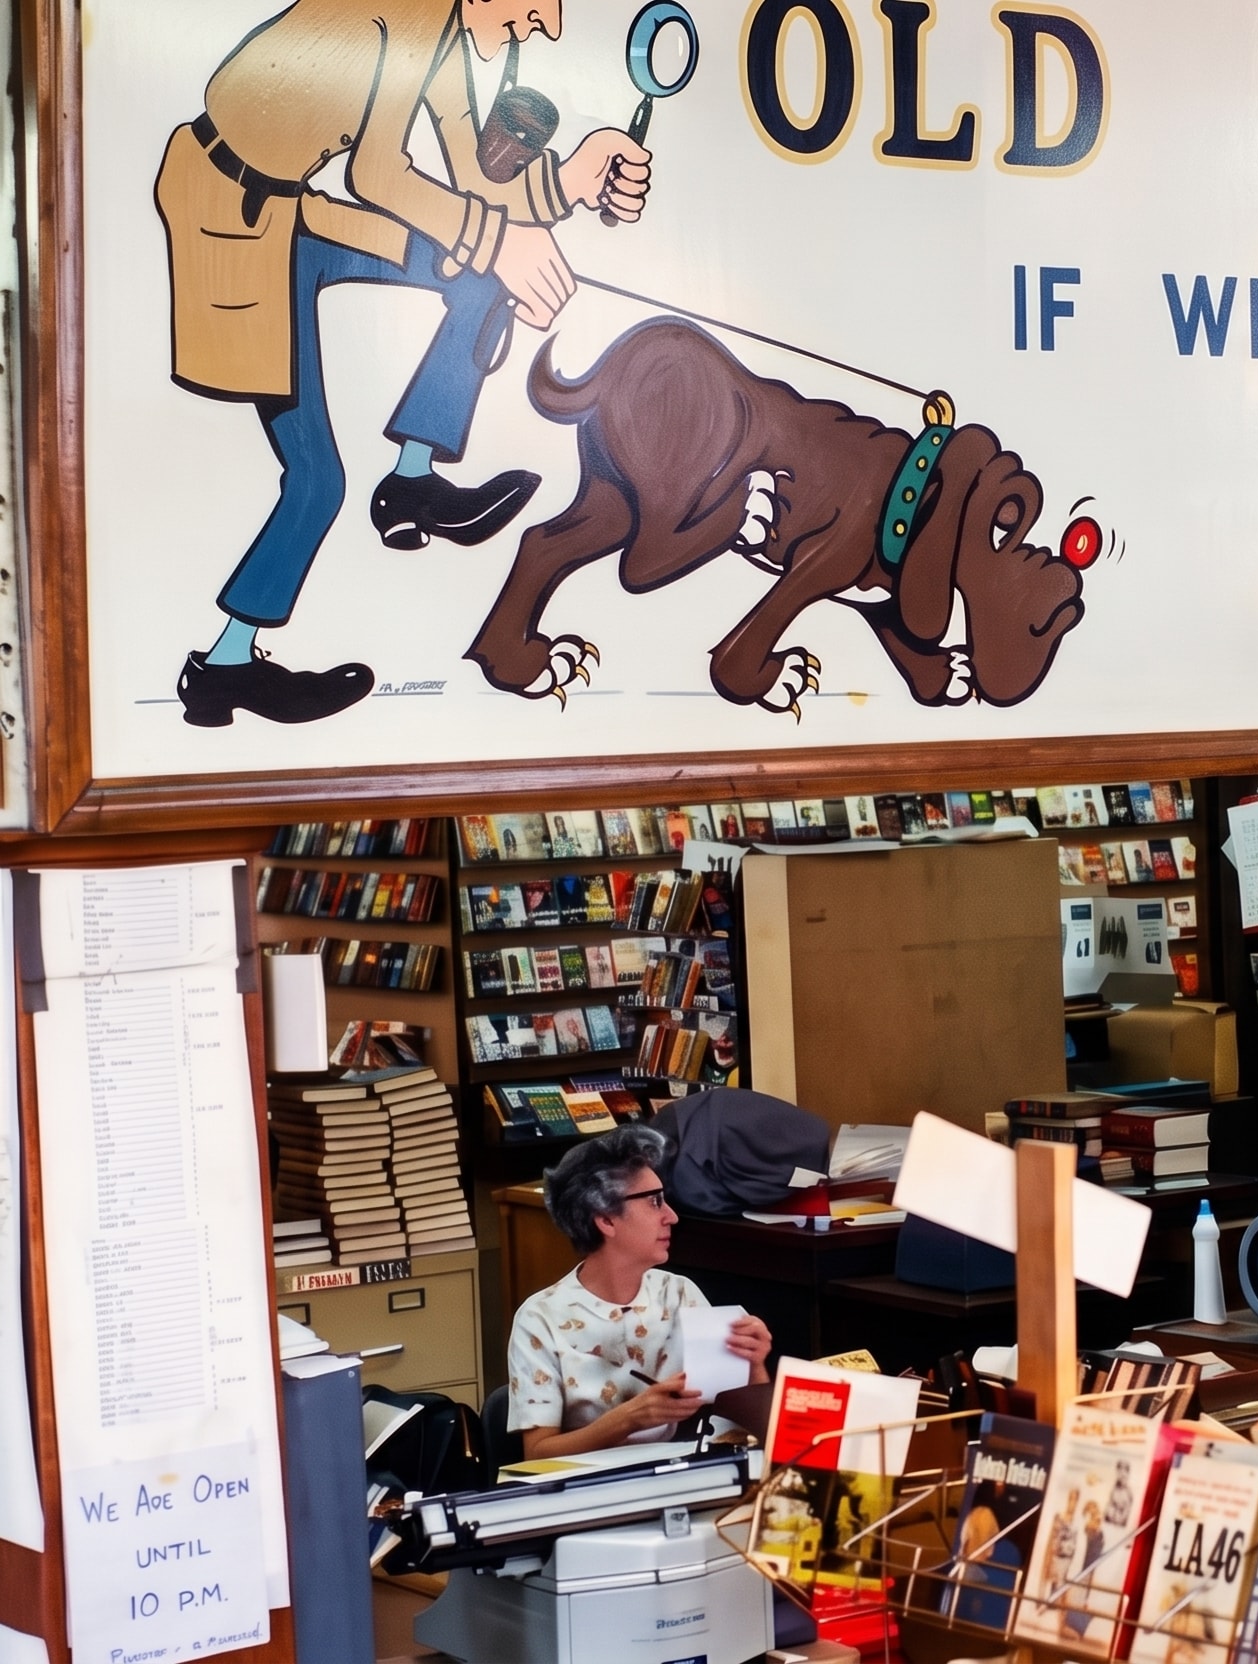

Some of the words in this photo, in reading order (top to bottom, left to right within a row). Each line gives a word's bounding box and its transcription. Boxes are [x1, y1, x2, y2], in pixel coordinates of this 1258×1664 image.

[744, 0, 1107, 171] OLD
[1013, 264, 1081, 352] IF
[79, 1491, 119, 1524] WE
[192, 1473, 250, 1504] OPEN
[135, 1538, 212, 1569] UNTIL
[130, 1591, 160, 1621] 10
[178, 1582, 229, 1613] P.M.
